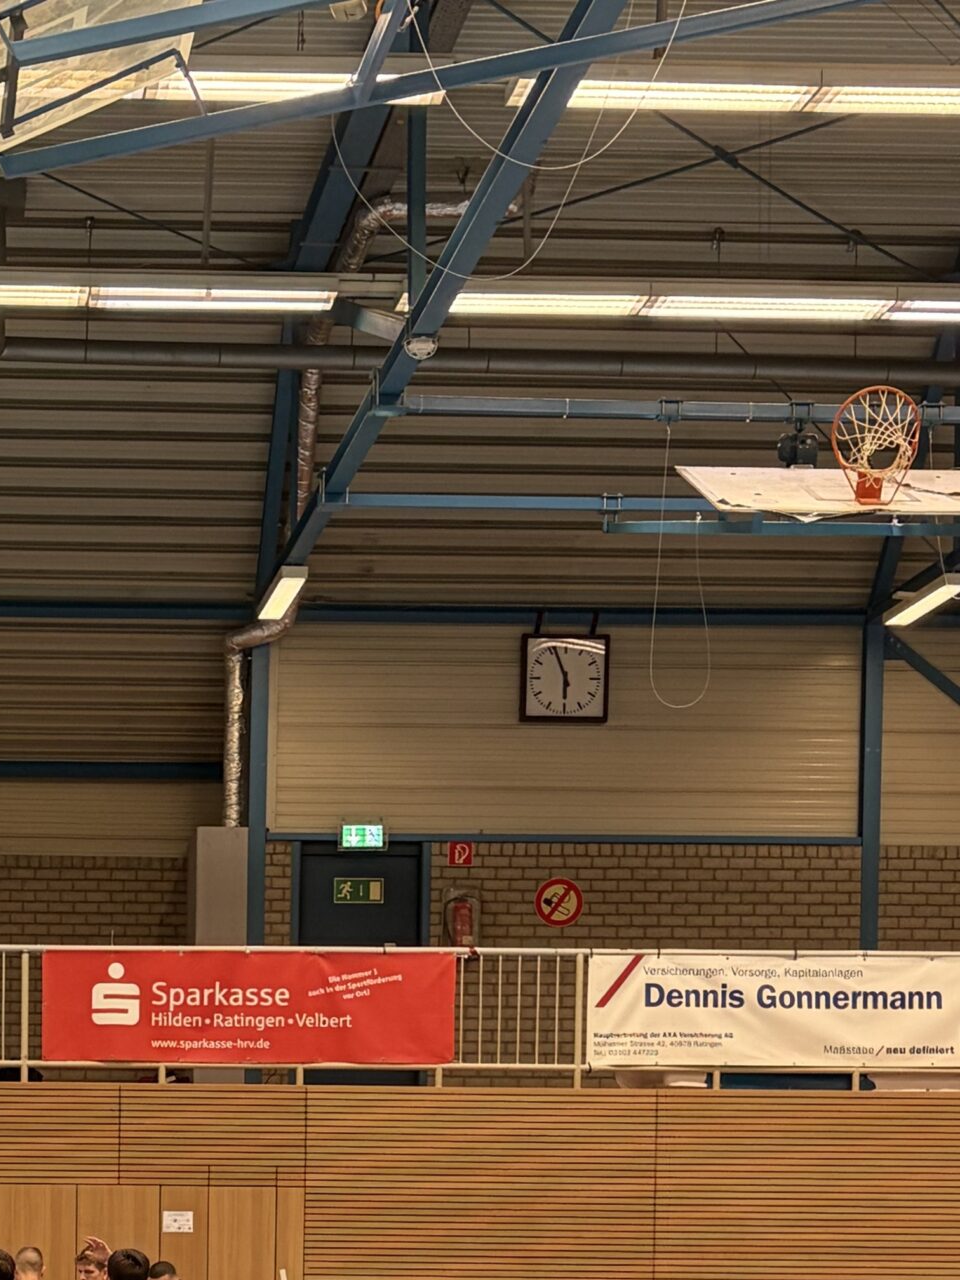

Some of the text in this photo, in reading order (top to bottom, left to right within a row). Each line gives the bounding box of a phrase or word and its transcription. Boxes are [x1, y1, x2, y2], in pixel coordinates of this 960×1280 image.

[784, 968, 863, 979] Kapitalanlagen
[151, 981, 290, 1011] Sparkasse
[644, 983, 943, 1010] Dennis Gonnermann
[151, 1013, 352, 1031] Hilden Ratingen Velbert
[151, 1038, 271, 1050] www.sparkasse-hrv.de
